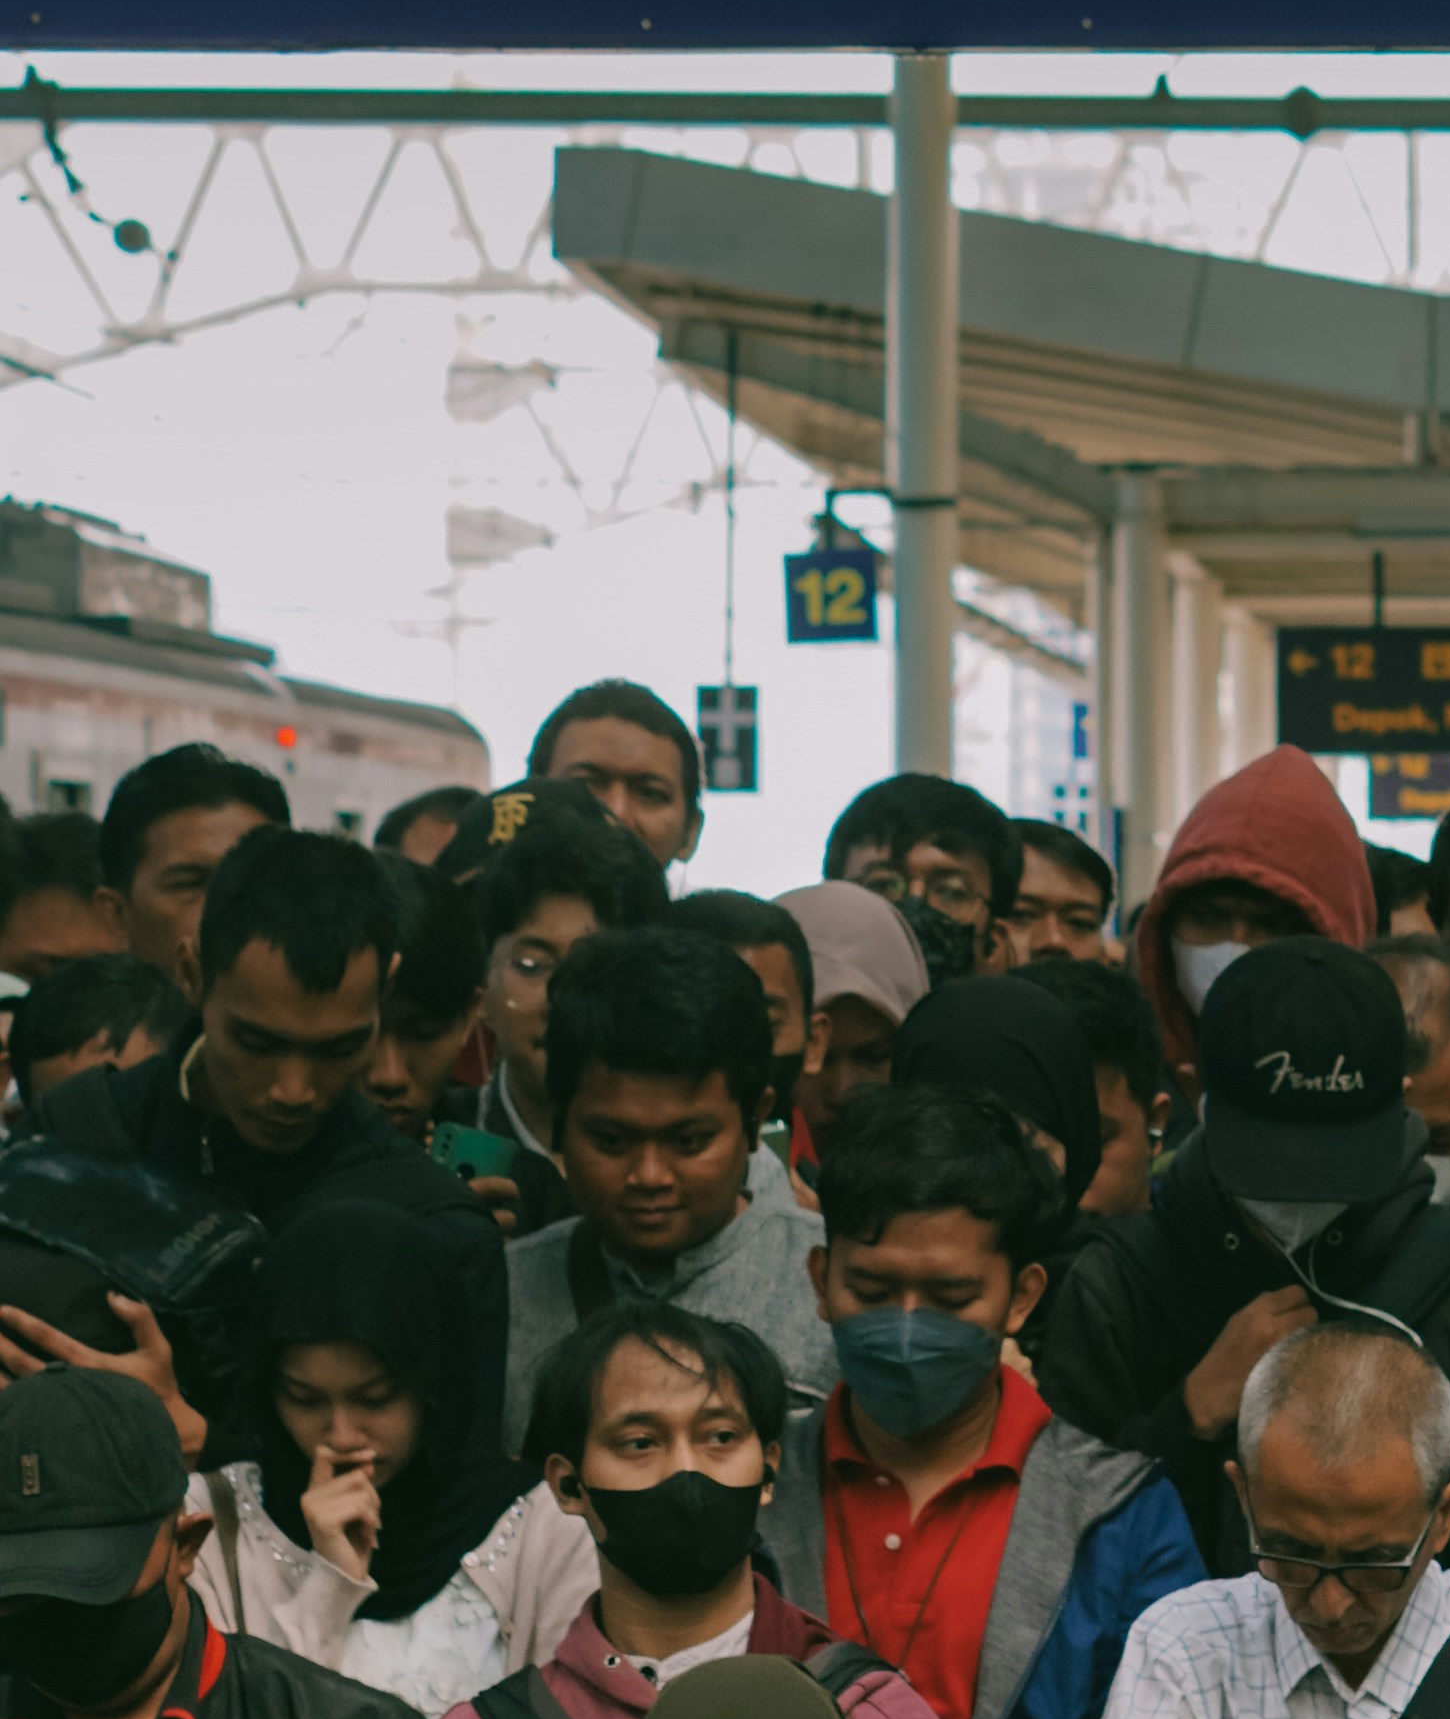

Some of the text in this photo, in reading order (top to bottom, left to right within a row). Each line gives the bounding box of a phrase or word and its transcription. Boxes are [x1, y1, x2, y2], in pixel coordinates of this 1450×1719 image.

[795, 567, 867, 626] 12
[1330, 642, 1376, 680] 12
[1254, 1050, 1365, 1095] Fender
